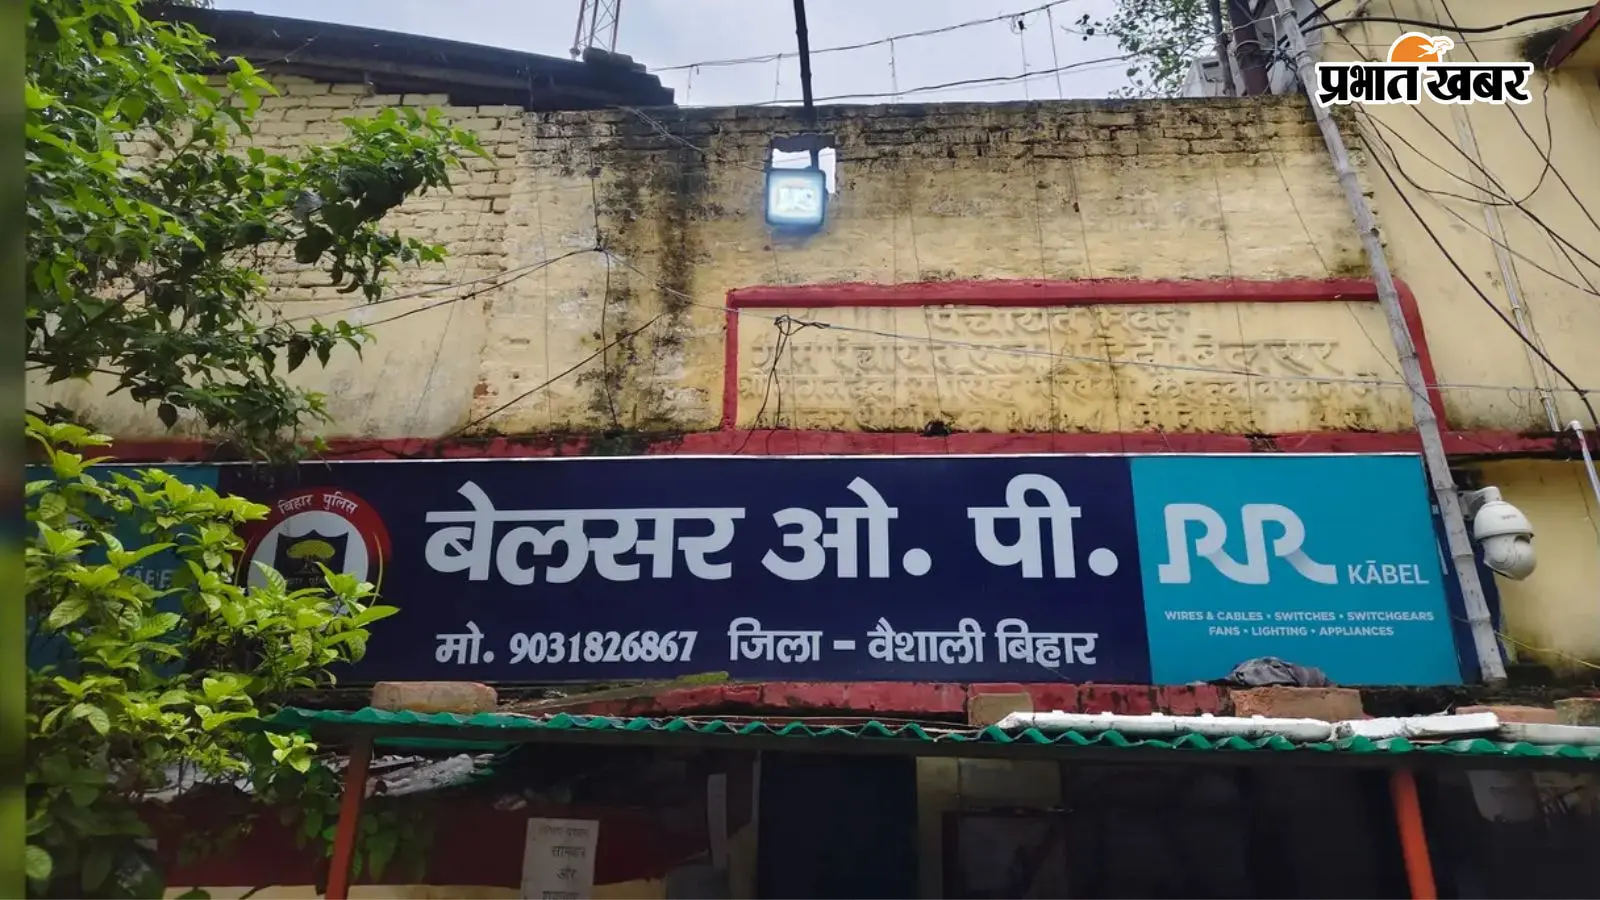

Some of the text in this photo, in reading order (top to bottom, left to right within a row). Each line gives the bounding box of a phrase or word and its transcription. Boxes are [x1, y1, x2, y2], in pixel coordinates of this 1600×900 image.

[277, 490, 359, 515] बिहार पुलिस
[424, 473, 1119, 586] बेलसर ओ. पी.
[1158, 503, 1429, 585] RR KĀBEL
[1164, 610, 1434, 621] WIRES & CABLES SWITCHES SWITCHGEARS
[1208, 626, 1394, 636] FANS LIGHTING APPLIANCES
[435, 620, 495, 664] मो.
[509, 630, 698, 665] 9031826867
[726, 616, 823, 664] जिला
[866, 616, 986, 665] वैशाली
[994, 618, 1099, 668] बिहार
